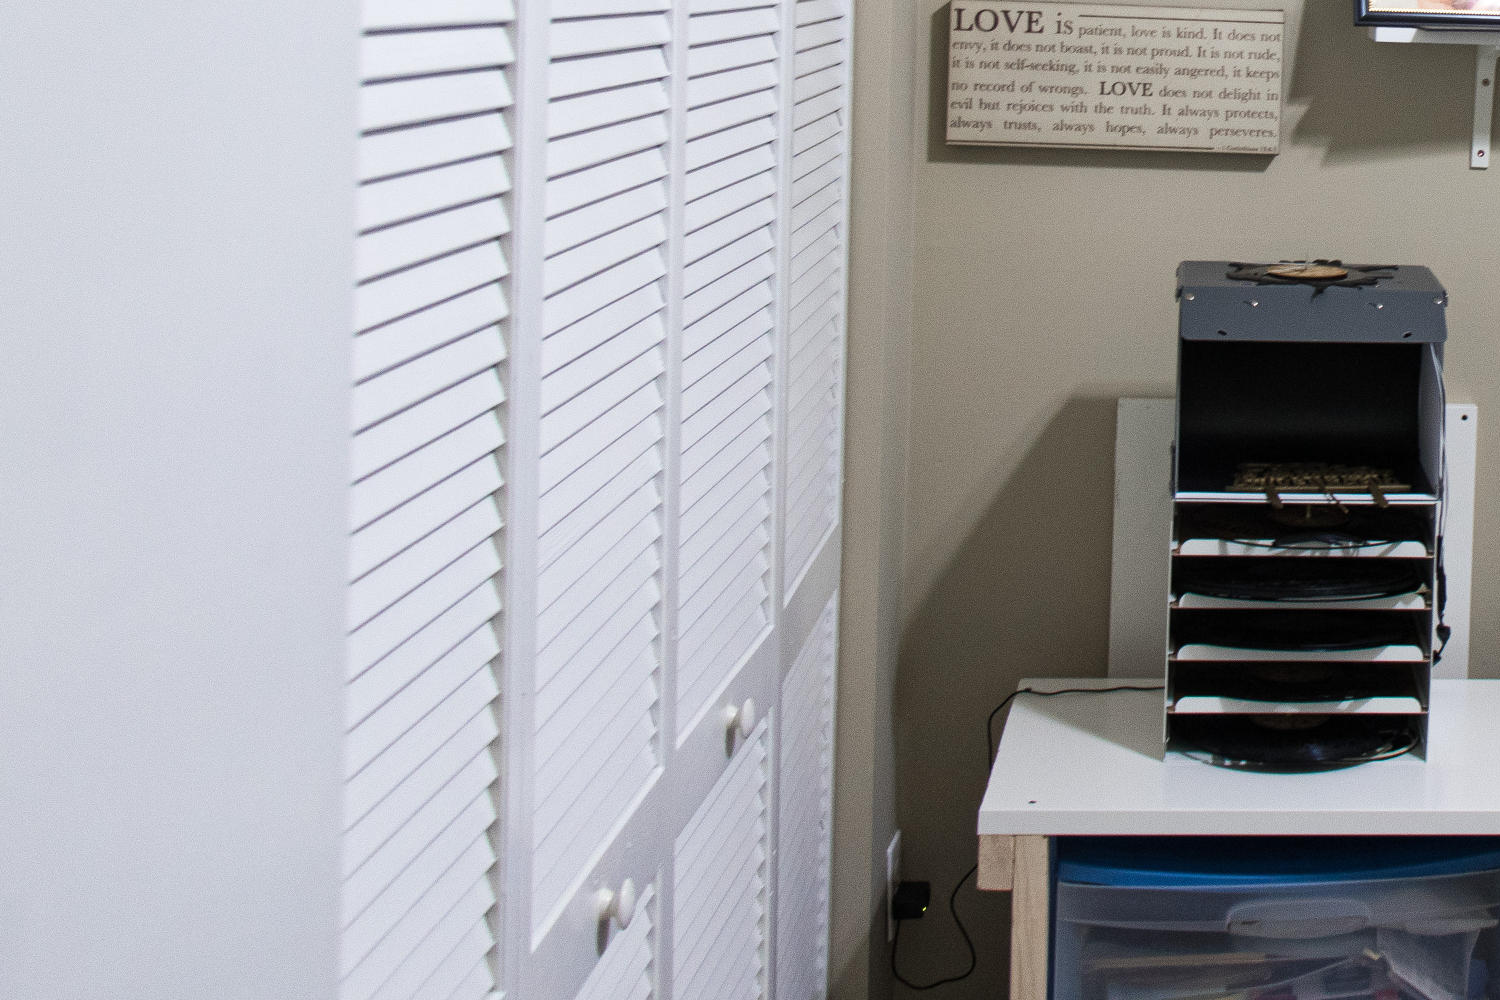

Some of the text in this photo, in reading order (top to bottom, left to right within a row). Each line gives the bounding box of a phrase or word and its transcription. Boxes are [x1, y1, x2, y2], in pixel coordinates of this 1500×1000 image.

[953, 8, 1281, 42] LOVE is patient, love is kind. It does not
[952, 41, 986, 53] envy,
[990, 39, 1000, 51] it
[1002, 40, 1032, 52] does
[1035, 42, 1056, 53] not
[1060, 41, 1097, 55] boast,
[1101, 42, 1109, 54] it
[1114, 43, 1123, 55] is
[1127, 46, 1147, 57] not
[1151, 46, 1192, 60] proud.
[1210, 46, 1219, 58] is
[1224, 49, 1244, 60] not
[1248, 49, 1280, 62] rude,
[951, 56, 960, 68] it
[965, 57, 975, 69] is
[978, 59, 1000, 70] not
[1084, 60, 1092, 73] it
[1097, 61, 1106, 73] is
[1111, 63, 1131, 74] not
[1136, 63, 1169, 79] easily
[1174, 65, 1228, 81] angered,
[1232, 66, 1241, 78] it
[951, 81, 1279, 103] no record of wrongs. LOVE does not delight in
[950, 98, 1278, 121] evil but rejoices with the truth. It always protects,
[950, 116, 1278, 139] always trusts, always hopes, always perseveres.
